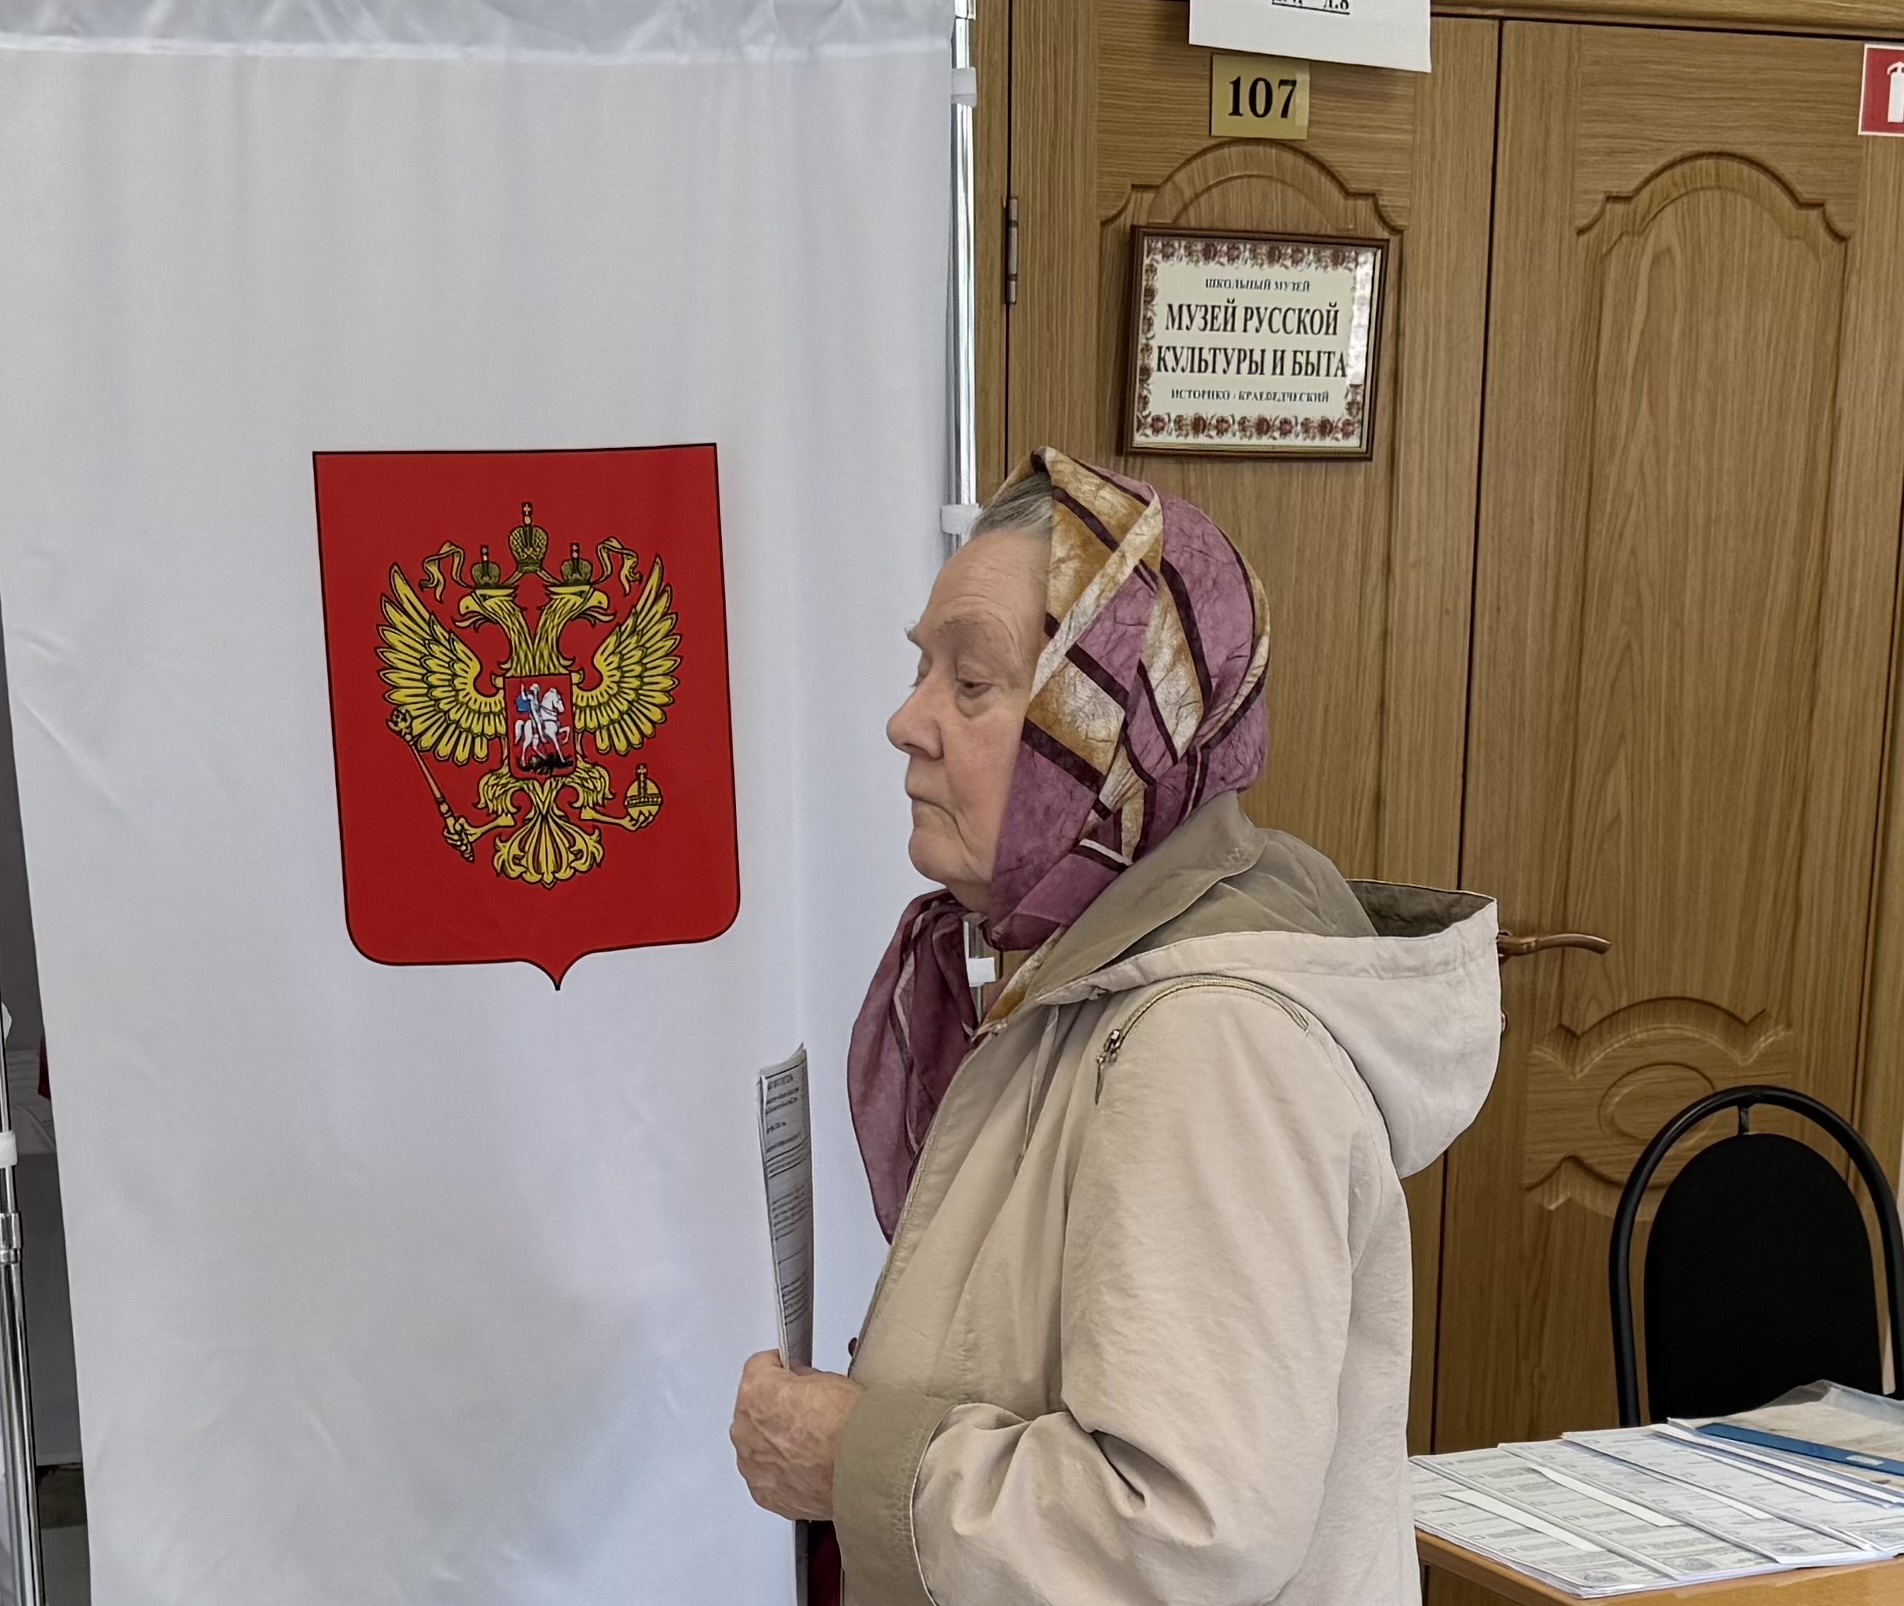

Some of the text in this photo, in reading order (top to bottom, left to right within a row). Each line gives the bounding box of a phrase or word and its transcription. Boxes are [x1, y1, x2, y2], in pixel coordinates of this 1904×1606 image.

[1228, 76, 1297, 119] 107
[1205, 278, 1310, 293] ШКОЛЬНЫЙ МУЗЕЙ
[1165, 297, 1339, 336] МУЗЕЙ РУССКОЙ
[1156, 346, 1348, 378] КУЛЬТУРЫ И БЫТА
